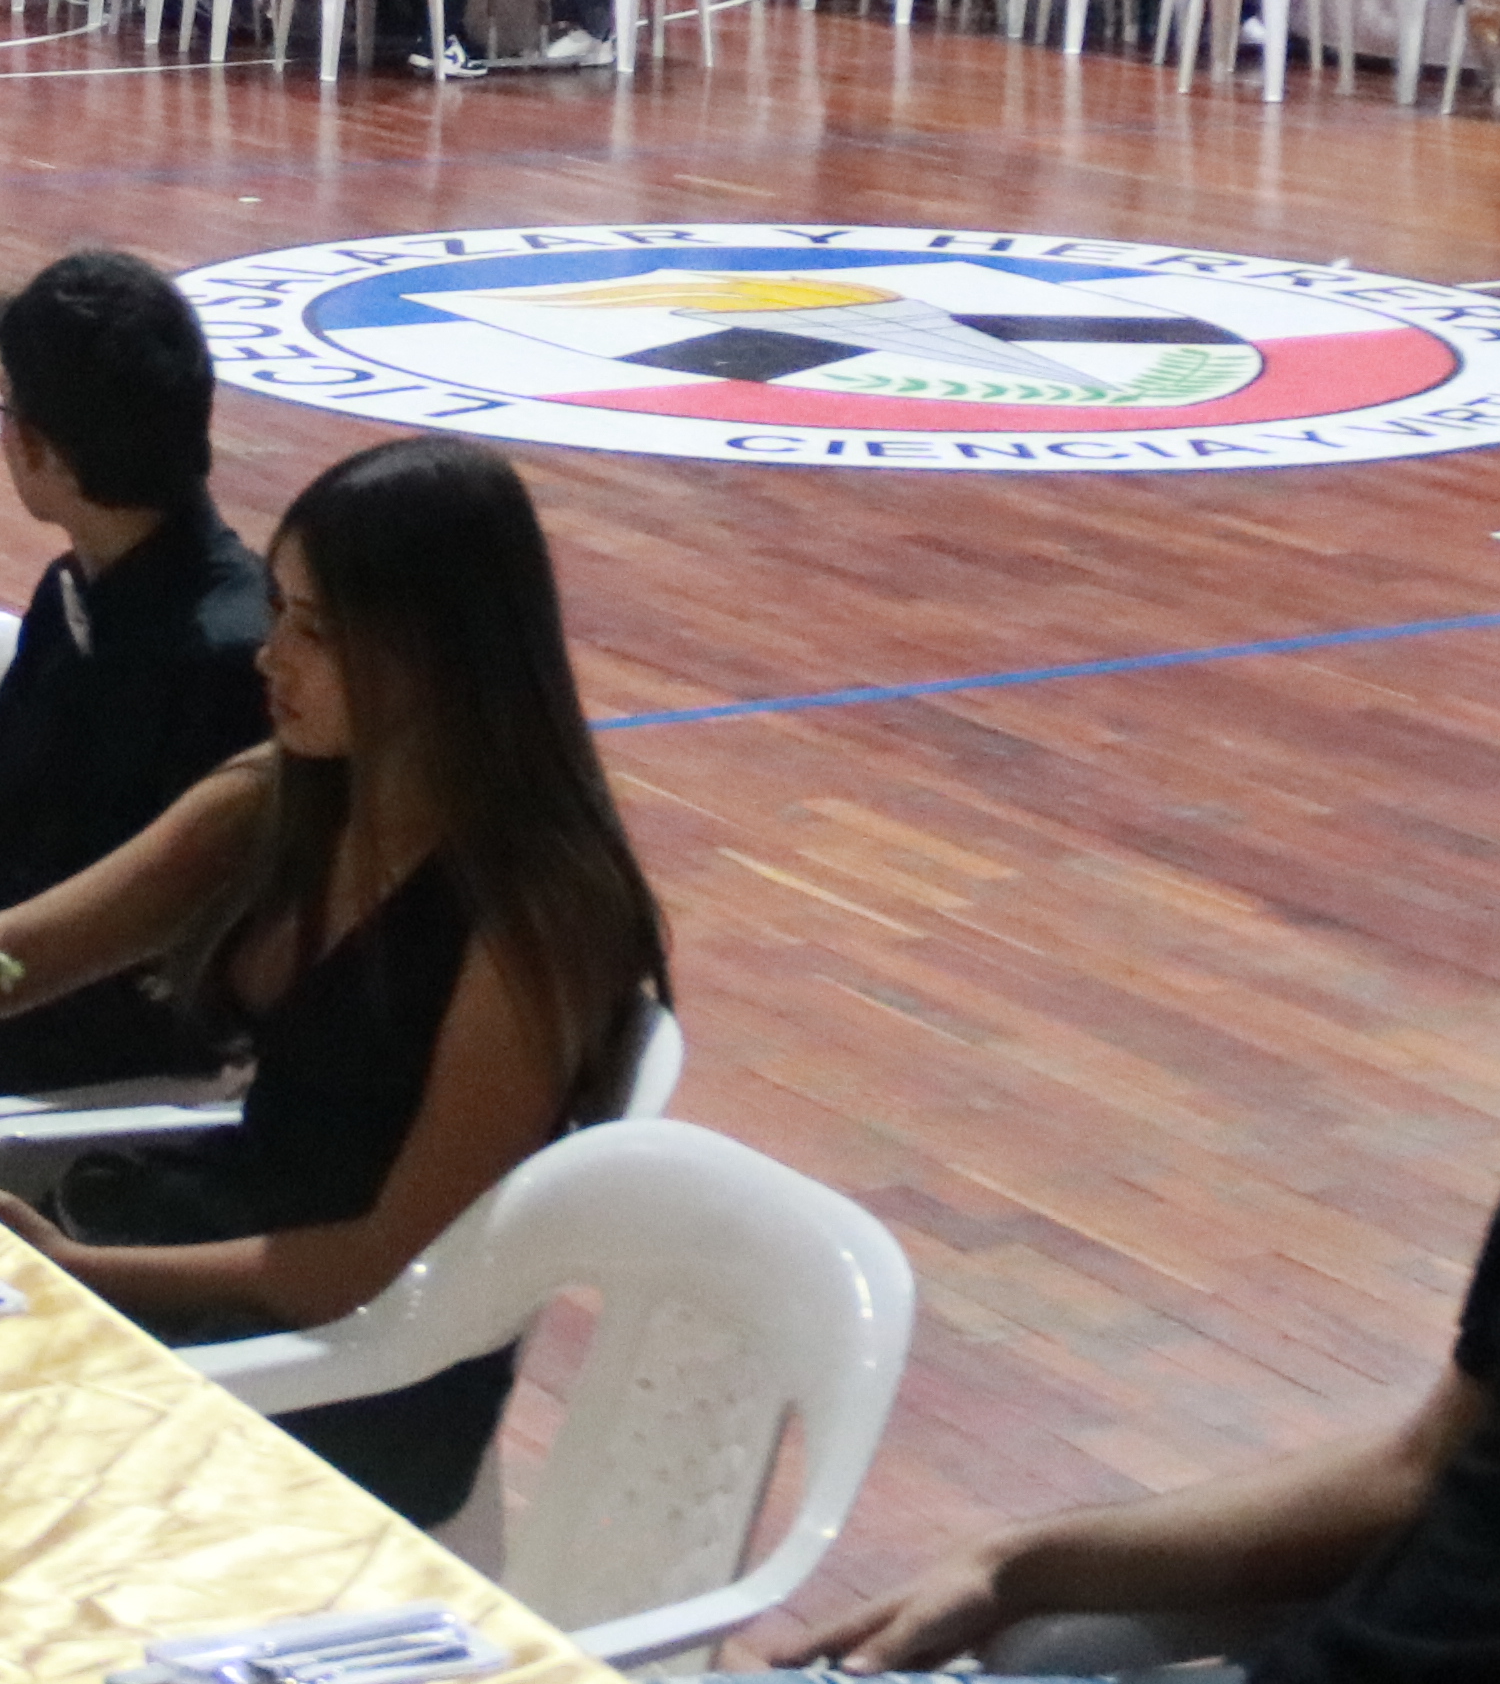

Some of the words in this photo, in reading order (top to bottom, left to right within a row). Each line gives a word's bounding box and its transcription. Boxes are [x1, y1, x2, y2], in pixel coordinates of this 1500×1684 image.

[184, 229, 719, 310] SALAZAR
[775, 228, 854, 246] Y
[726, 434, 1258, 461] CIENCIA
[1261, 429, 1348, 449] Y
